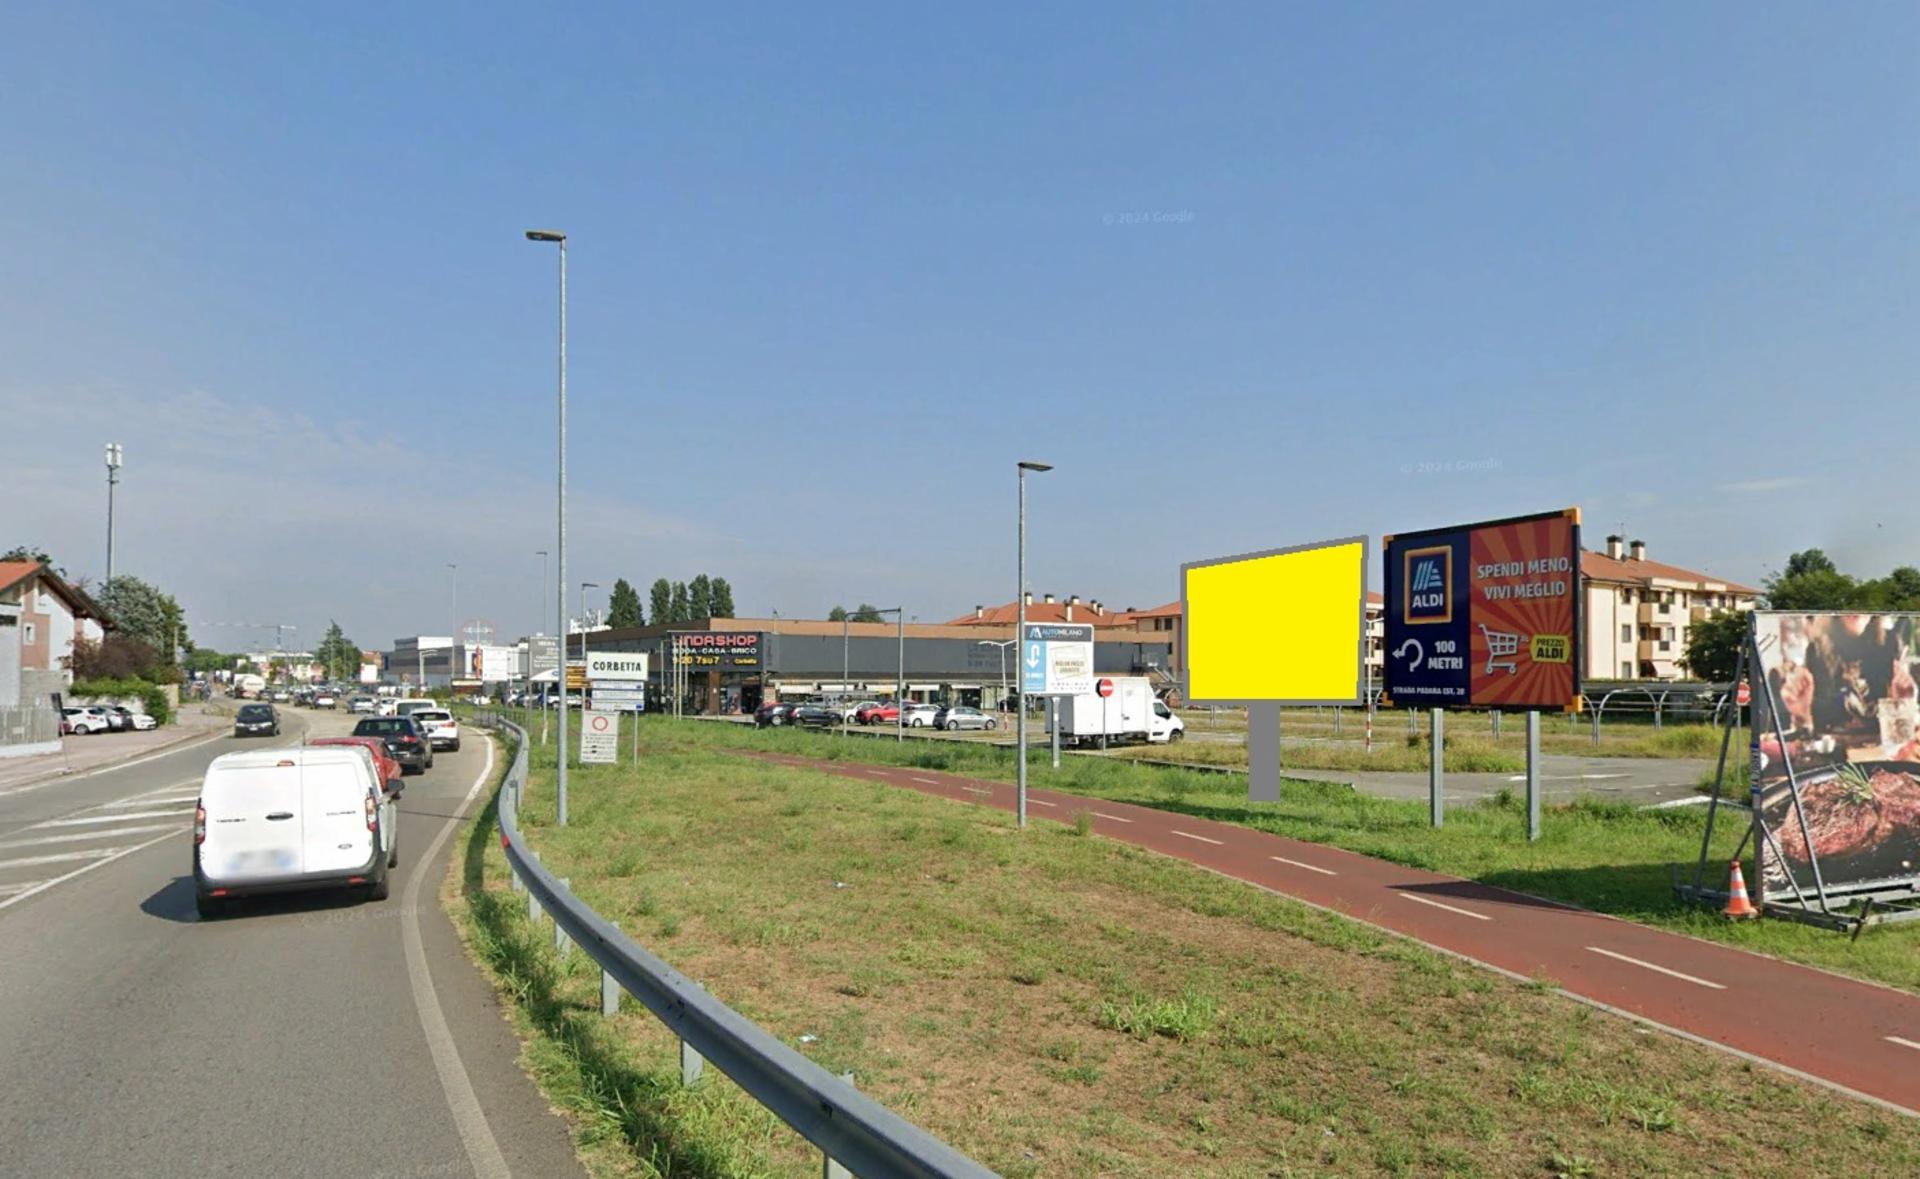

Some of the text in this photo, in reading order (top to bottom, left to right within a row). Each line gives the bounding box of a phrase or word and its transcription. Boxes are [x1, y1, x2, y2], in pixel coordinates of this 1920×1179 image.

[1477, 561, 1524, 578] SPENDI
[1484, 581, 1565, 600] VIVI MEGLIO
[1412, 593, 1444, 608] ALDI
[1434, 640, 1456, 653] 100
[1536, 638, 1565, 646] PREZZO
[1536, 647, 1564, 659] ALDI
[592, 661, 642, 672] CORBETTA
[1427, 656, 1463, 670] METRI
